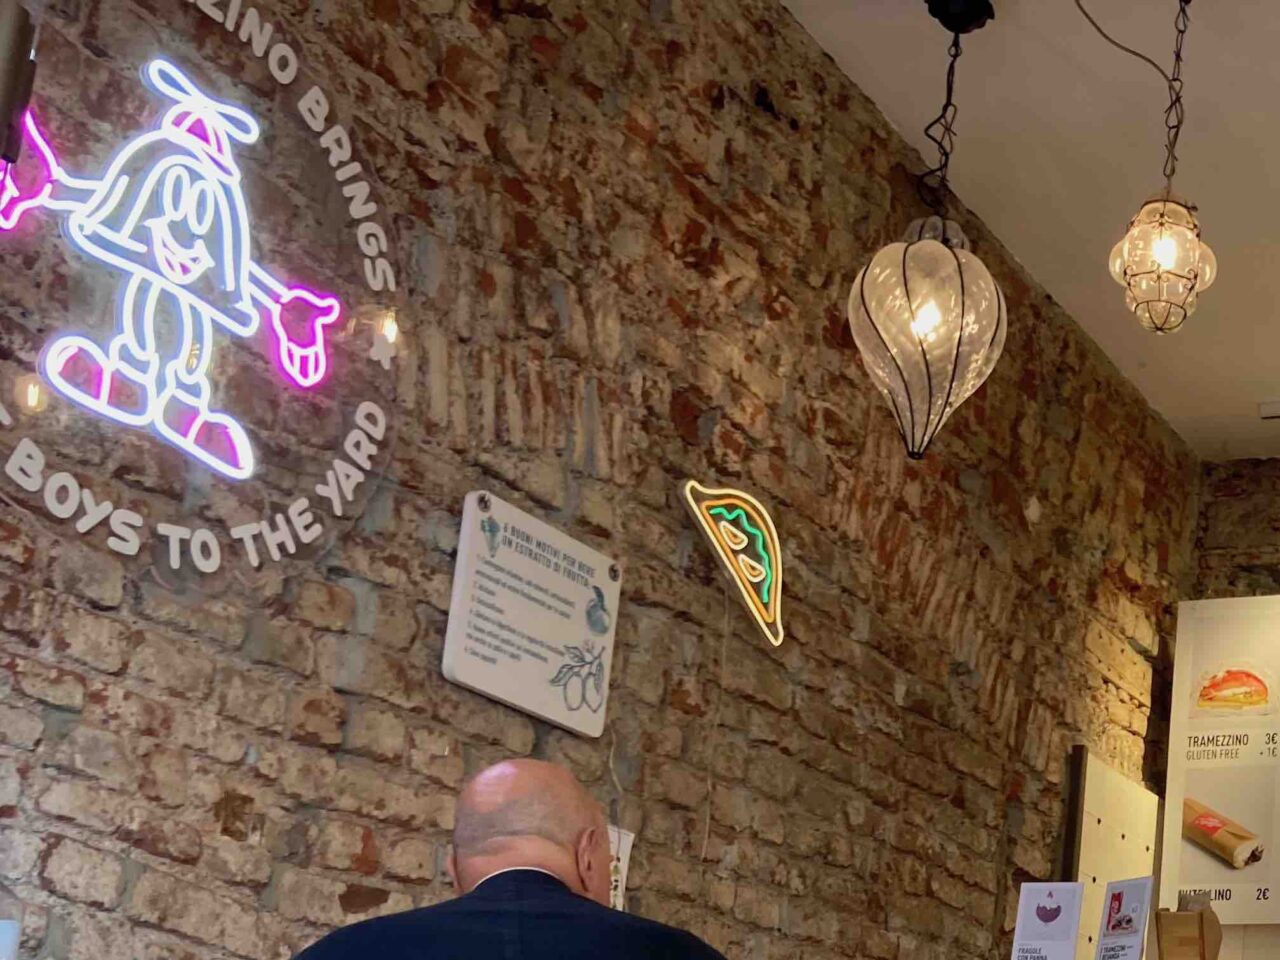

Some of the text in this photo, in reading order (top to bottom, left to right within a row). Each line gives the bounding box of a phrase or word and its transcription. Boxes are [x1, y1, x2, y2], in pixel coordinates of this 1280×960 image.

[297, 85, 396, 292] BRINGS
[5, 401, 386, 573] BOYS TO THE YARD
[510, 525, 533, 546] BUONI
[536, 538, 560, 559] MOTIVI
[563, 553, 577, 568] PER
[577, 559, 597, 578] BERE
[515, 542, 552, 569] ESTRATTO
[552, 562, 562, 573] DI
[1186, 750, 1216, 761] GLUTEN
[1219, 749, 1240, 760] FREE
[1187, 732, 1278, 749] TRAMEZZINO 3€
[1256, 887, 1270, 901] 2€
